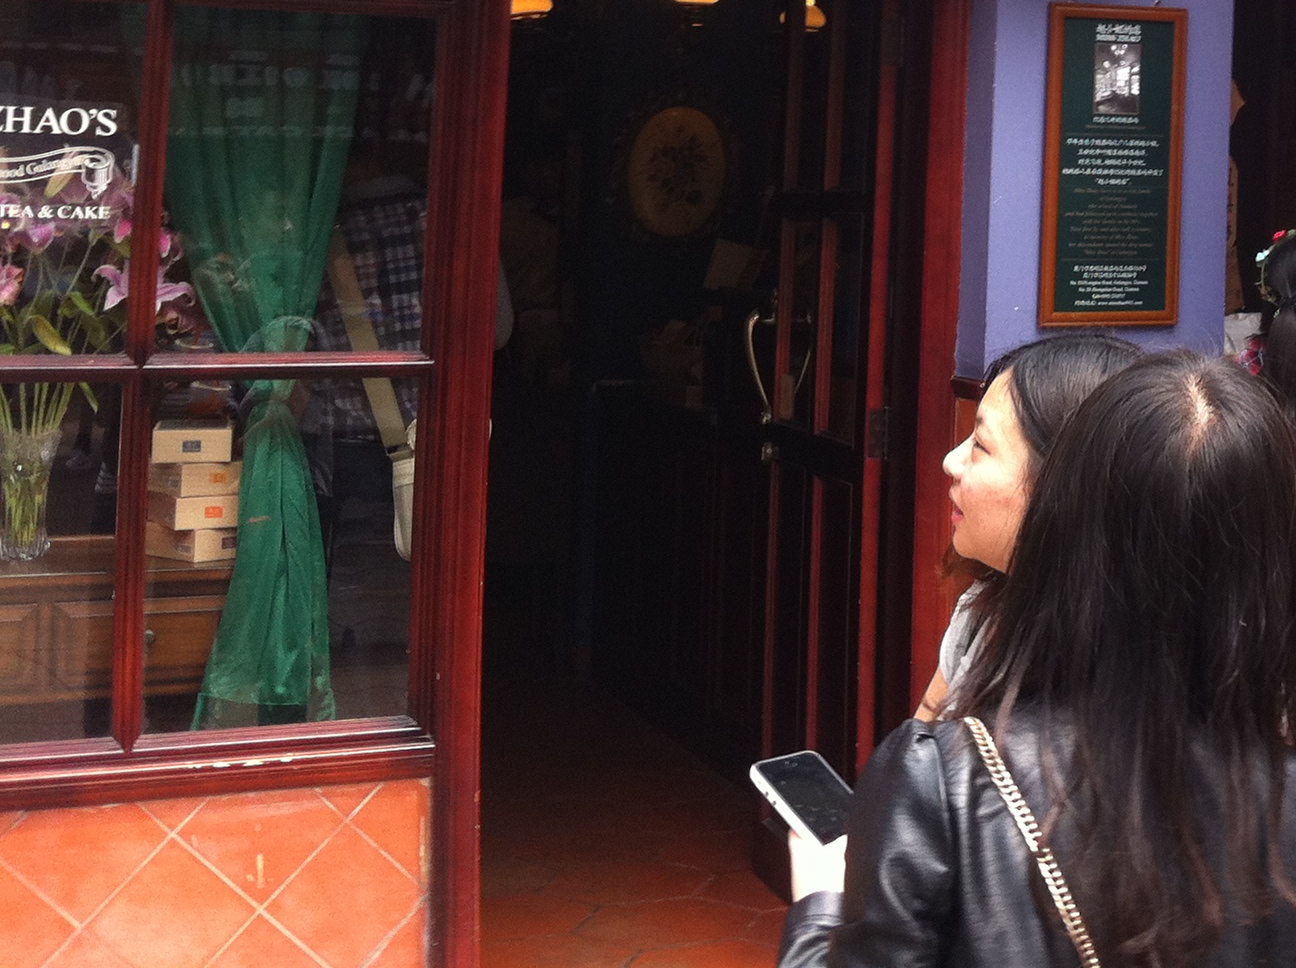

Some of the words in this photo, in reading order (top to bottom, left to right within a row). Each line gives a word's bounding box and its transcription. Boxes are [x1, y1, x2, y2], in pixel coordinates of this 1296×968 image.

[0, 106, 118, 137] HAO'S
[37, 204, 54, 219] &
[57, 205, 111, 220] CAKE
